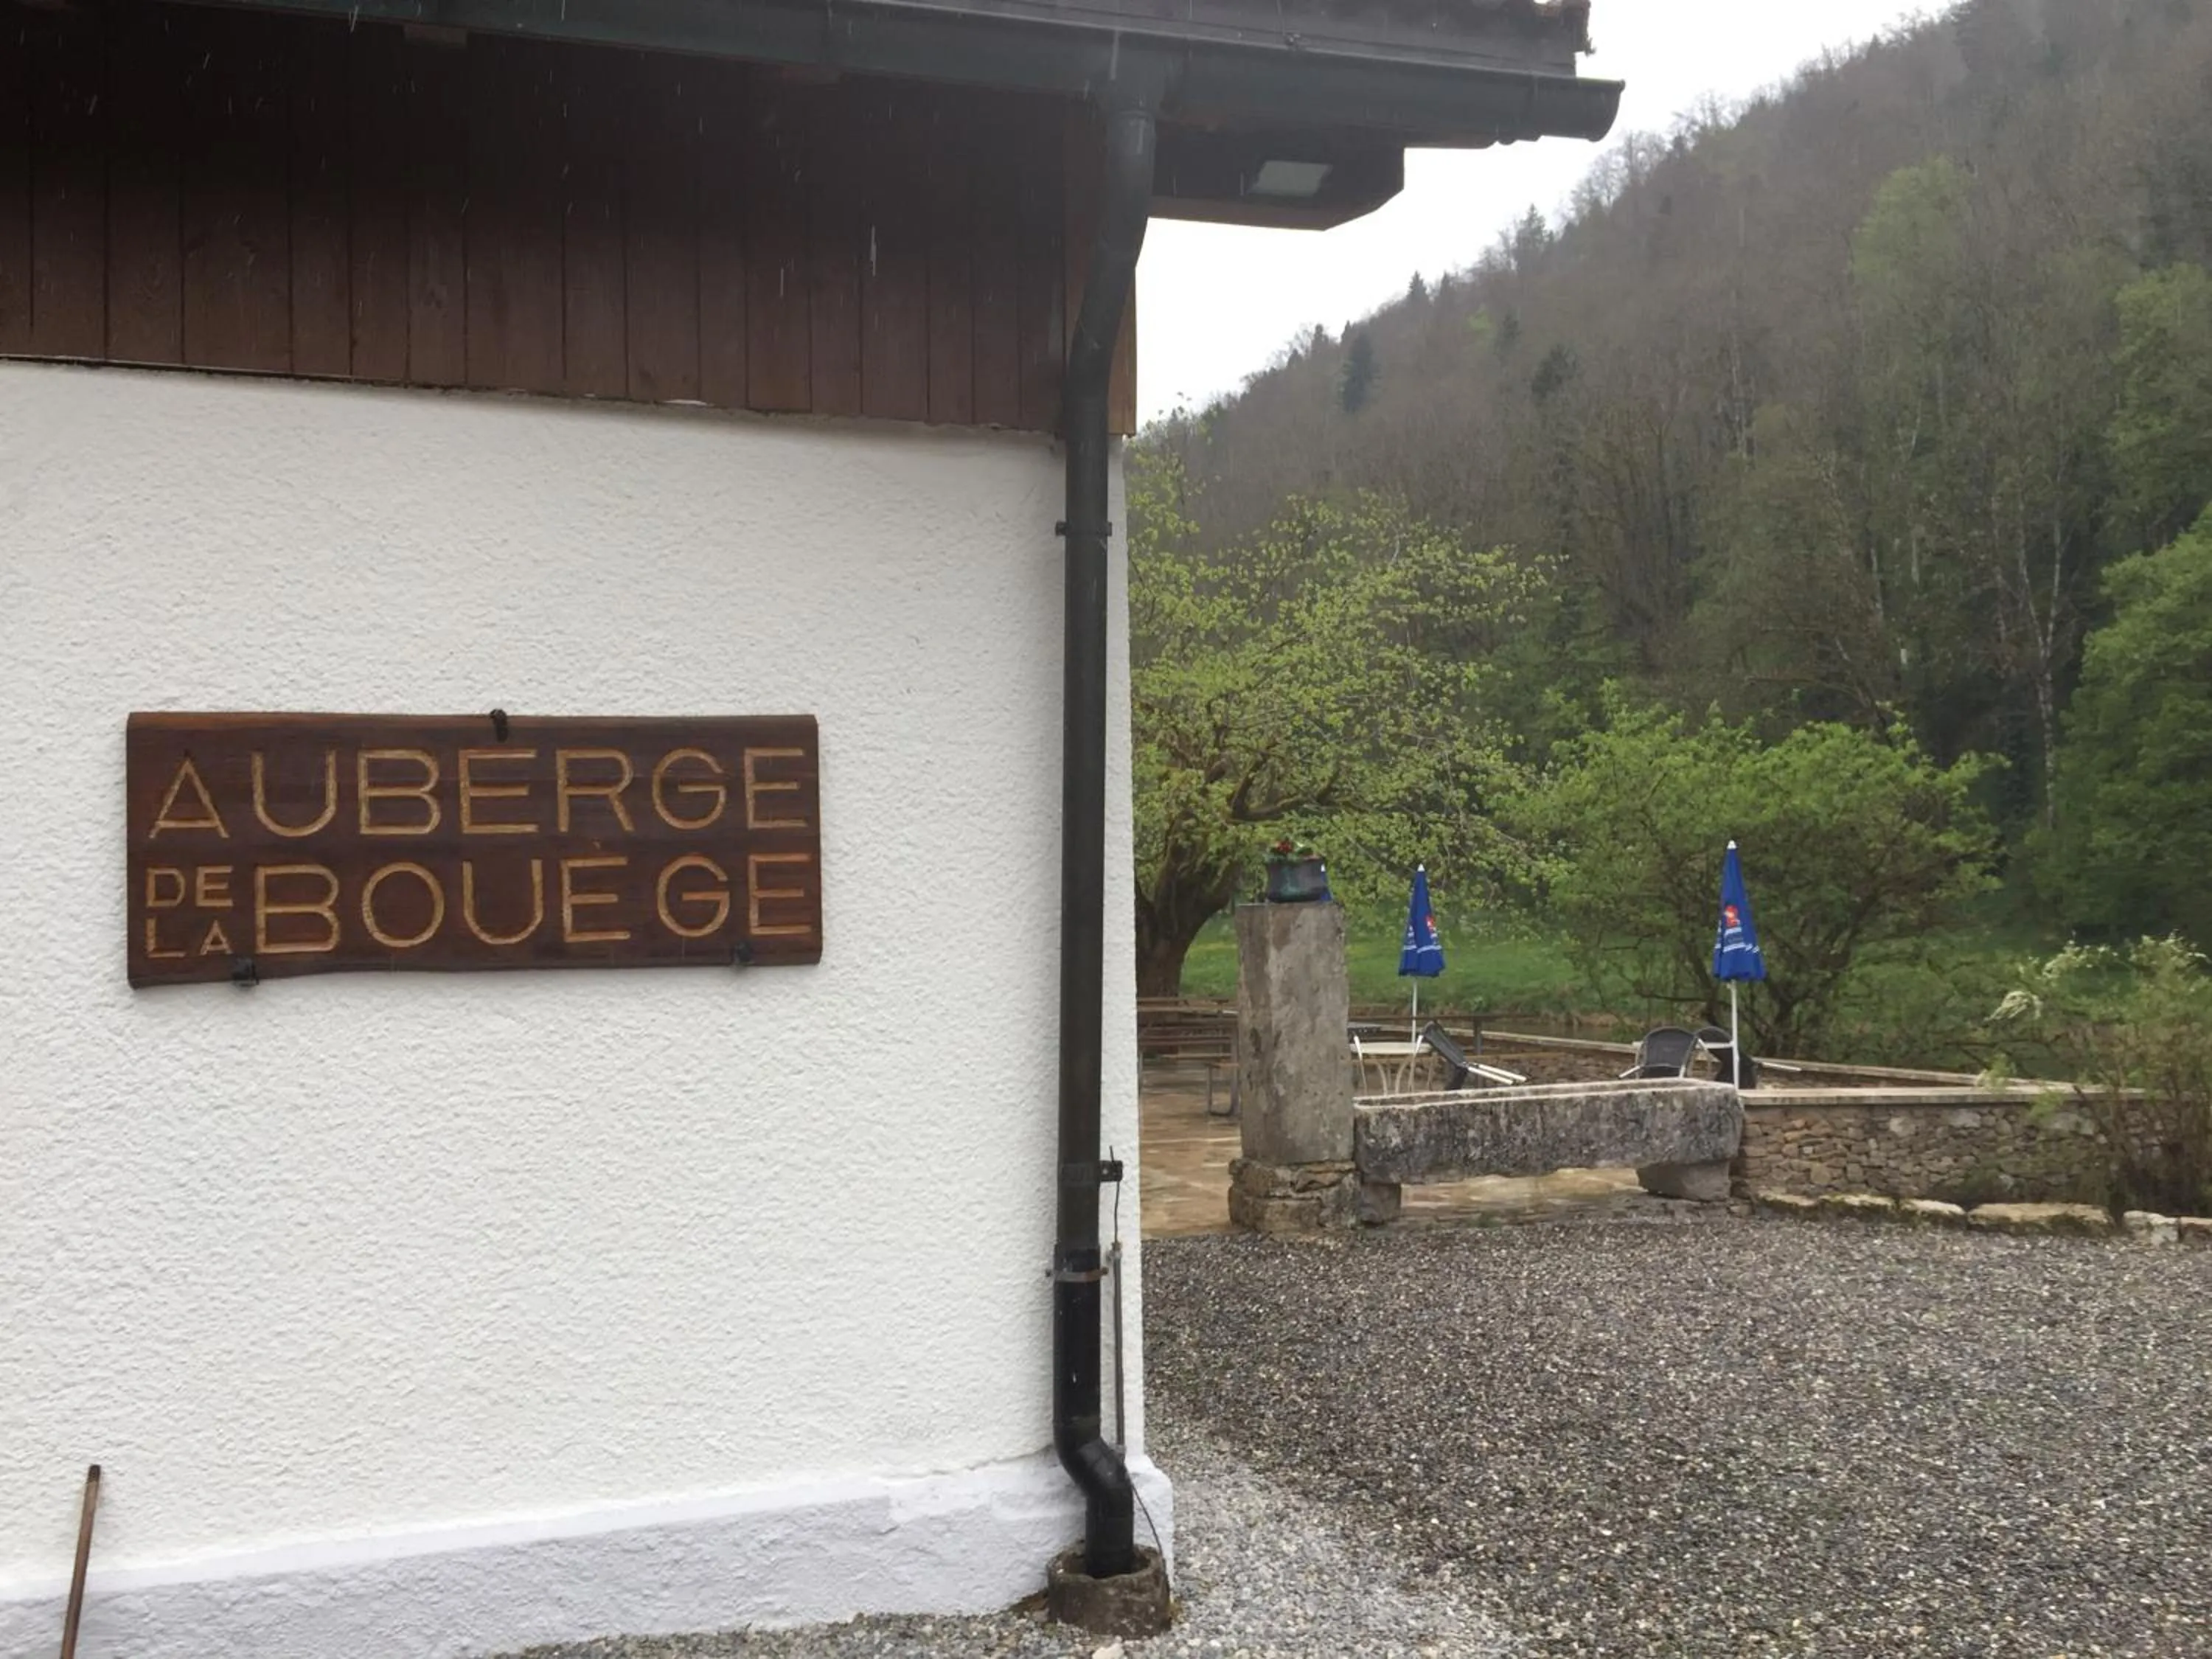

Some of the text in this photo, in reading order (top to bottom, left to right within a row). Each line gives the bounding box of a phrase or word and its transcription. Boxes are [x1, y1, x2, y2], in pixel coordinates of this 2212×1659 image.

[150, 747, 807, 838] AUBERGE
[146, 866, 234, 908] DE
[146, 917, 234, 958] LA
